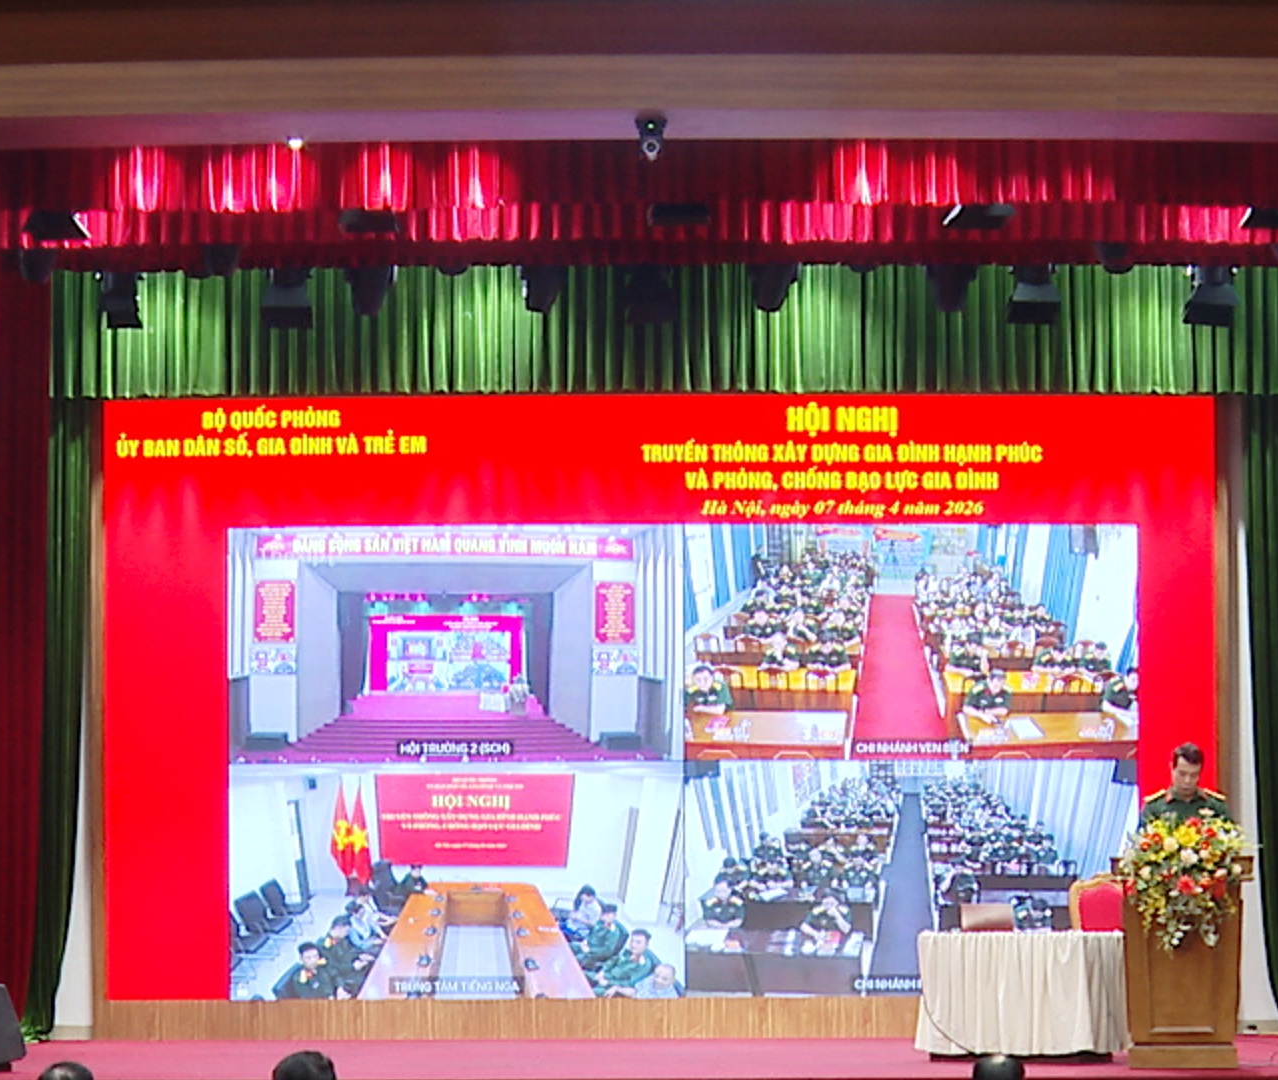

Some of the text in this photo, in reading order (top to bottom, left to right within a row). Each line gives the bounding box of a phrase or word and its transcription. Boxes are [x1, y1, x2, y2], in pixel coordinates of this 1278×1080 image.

[201, 404, 341, 433] BỘ QUỐC PHÒNG
[786, 401, 899, 438] HỘI NGHỊ
[116, 429, 427, 458] ỦY BAN DÂN SỐ, GIA ĐÌNH VÀ TRẺ EM
[710, 440, 770, 463] THÔNG
[771, 439, 808, 463] XÂY
[811, 442, 861, 466] DỰNG
[863, 443, 894, 463] GIA
[896, 440, 941, 463] ĐÌNH
[943, 444, 993, 467] HẠNH
[995, 441, 1043, 463] PHÚC
[684, 466, 999, 493] VÀ PHÒNG, CHỐNG BẠO LỰC GIA ĐÌNH
[700, 499, 984, 519] Hà Nội, ngày 07 tháng 4 năm 2026
